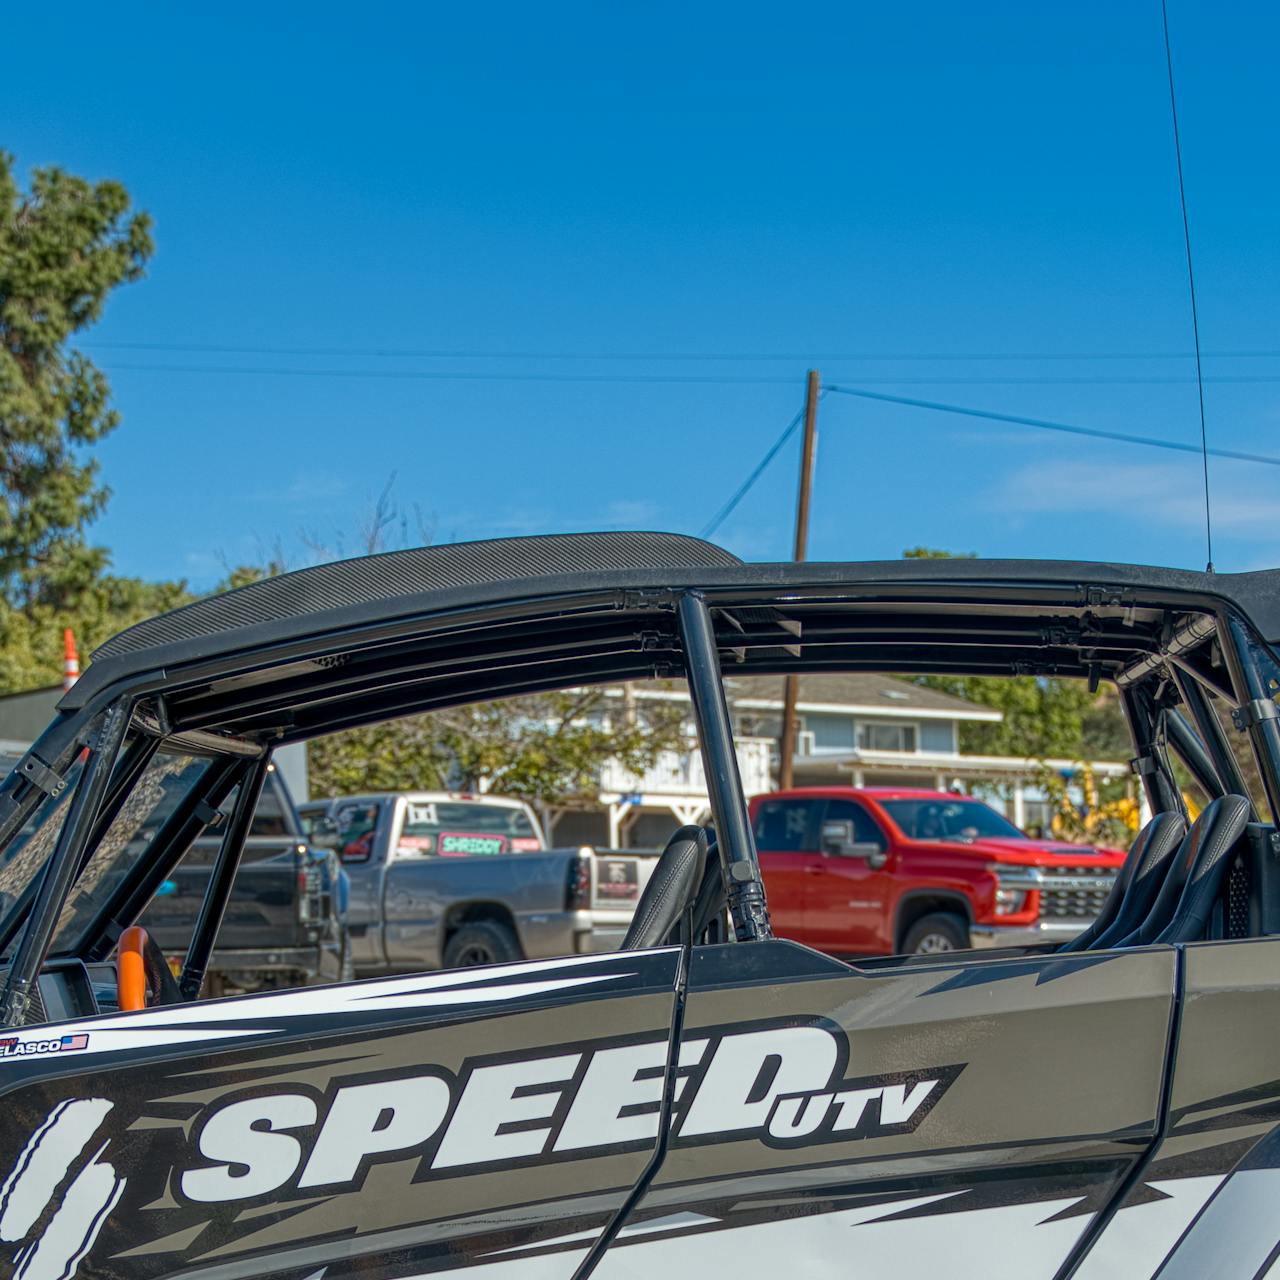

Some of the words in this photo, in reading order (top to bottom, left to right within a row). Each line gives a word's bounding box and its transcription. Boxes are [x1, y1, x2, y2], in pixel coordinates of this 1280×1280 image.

[443, 836, 502, 854] SHREDDY
[181, 1026, 839, 1202] SPEED
[768, 1080, 939, 1139] UTV
